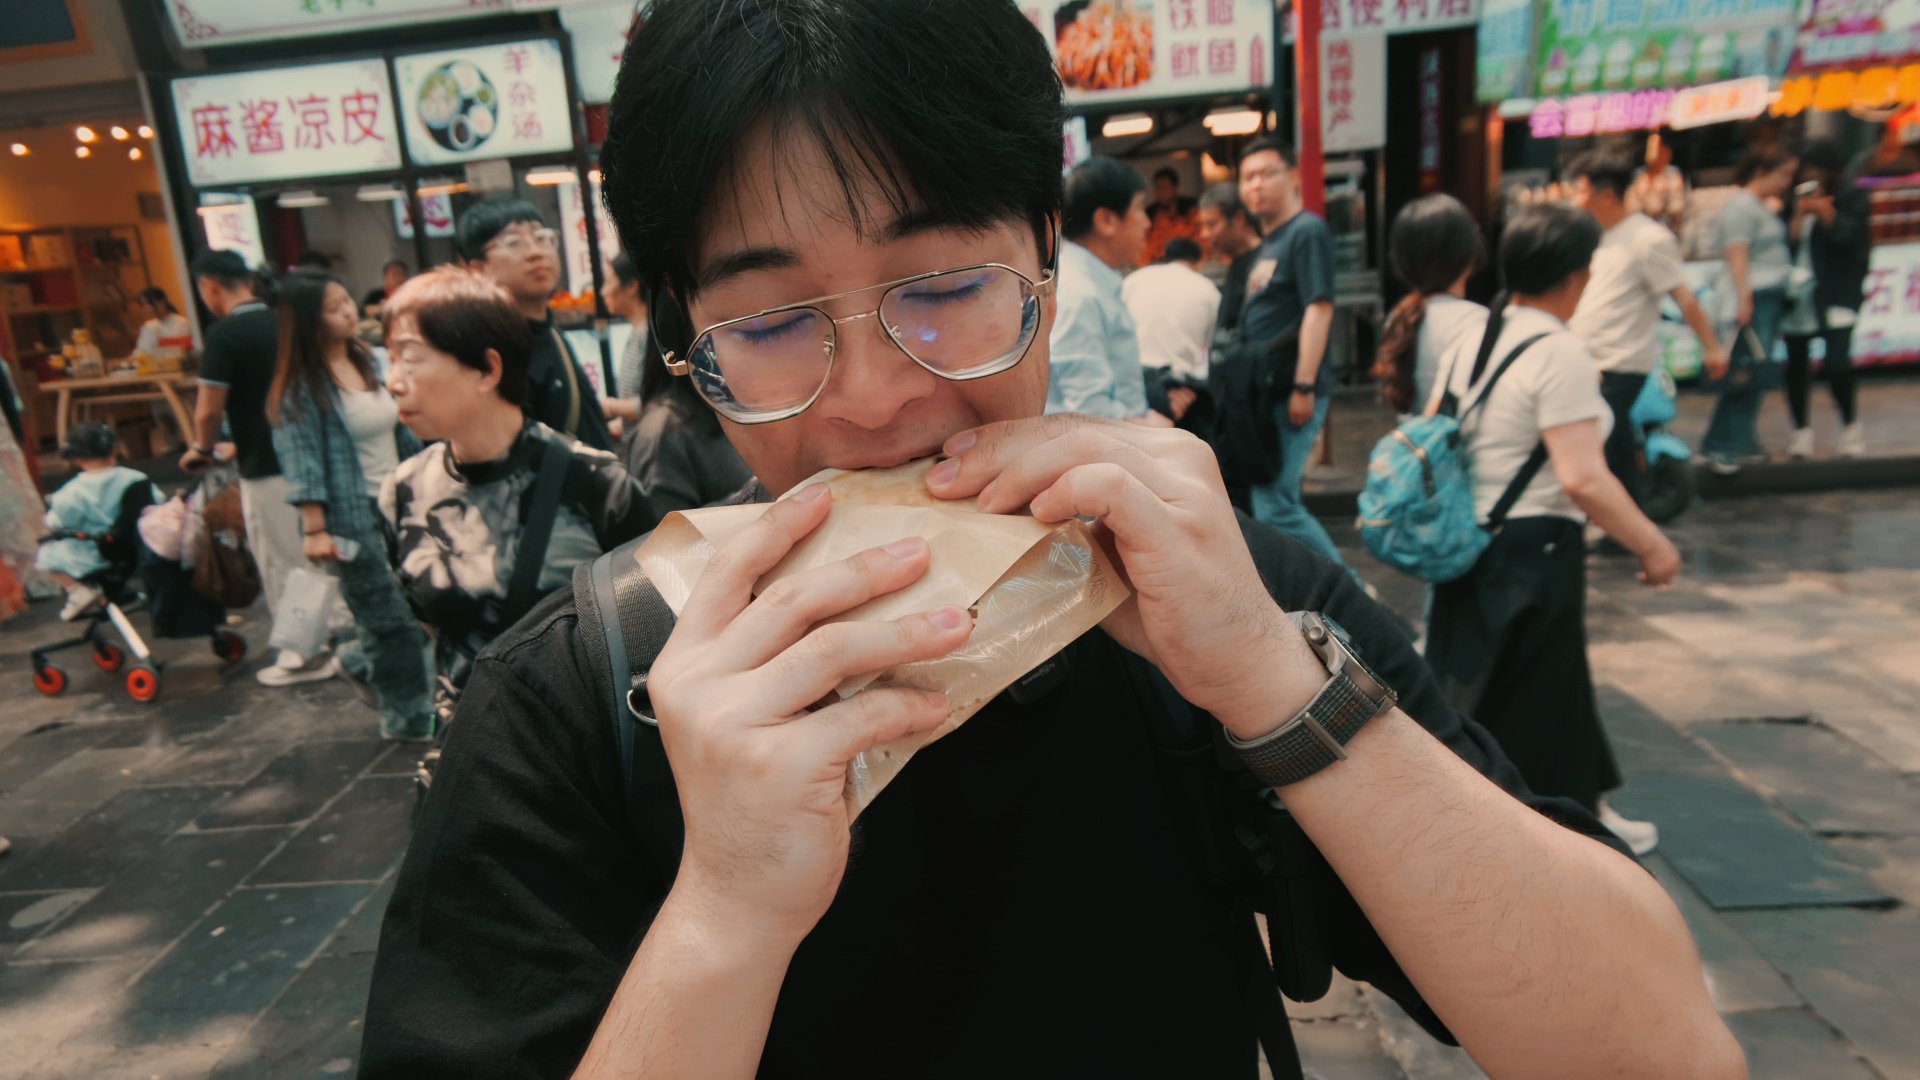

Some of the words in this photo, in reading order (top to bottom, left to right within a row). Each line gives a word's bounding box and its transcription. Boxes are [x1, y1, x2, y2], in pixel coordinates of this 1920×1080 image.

[504, 45, 542, 139] 羊杂汤
[1170, 38, 1236, 77] 鱿鱼
[191, 87, 385, 157] 麻酱凉皮
